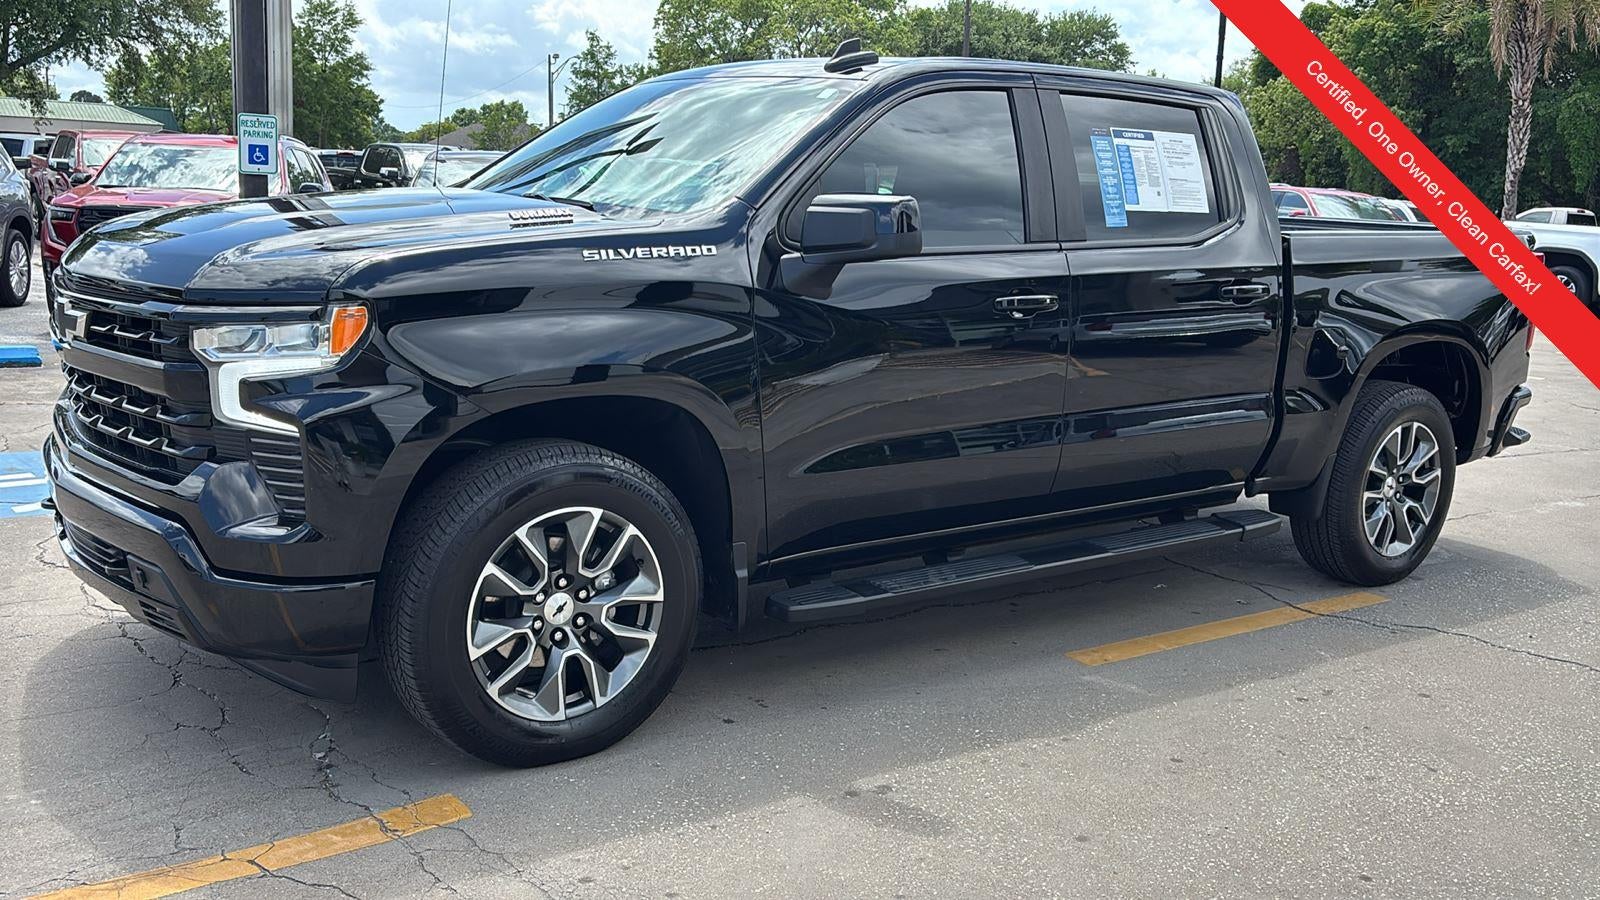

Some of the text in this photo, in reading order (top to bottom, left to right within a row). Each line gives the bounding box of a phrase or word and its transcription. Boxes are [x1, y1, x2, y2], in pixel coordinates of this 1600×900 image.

[241, 120, 275, 129] RESERVED
[243, 130, 273, 139] PARKING
[508, 207, 573, 220] DURAMAX
[582, 245, 718, 262] SILVERADO
